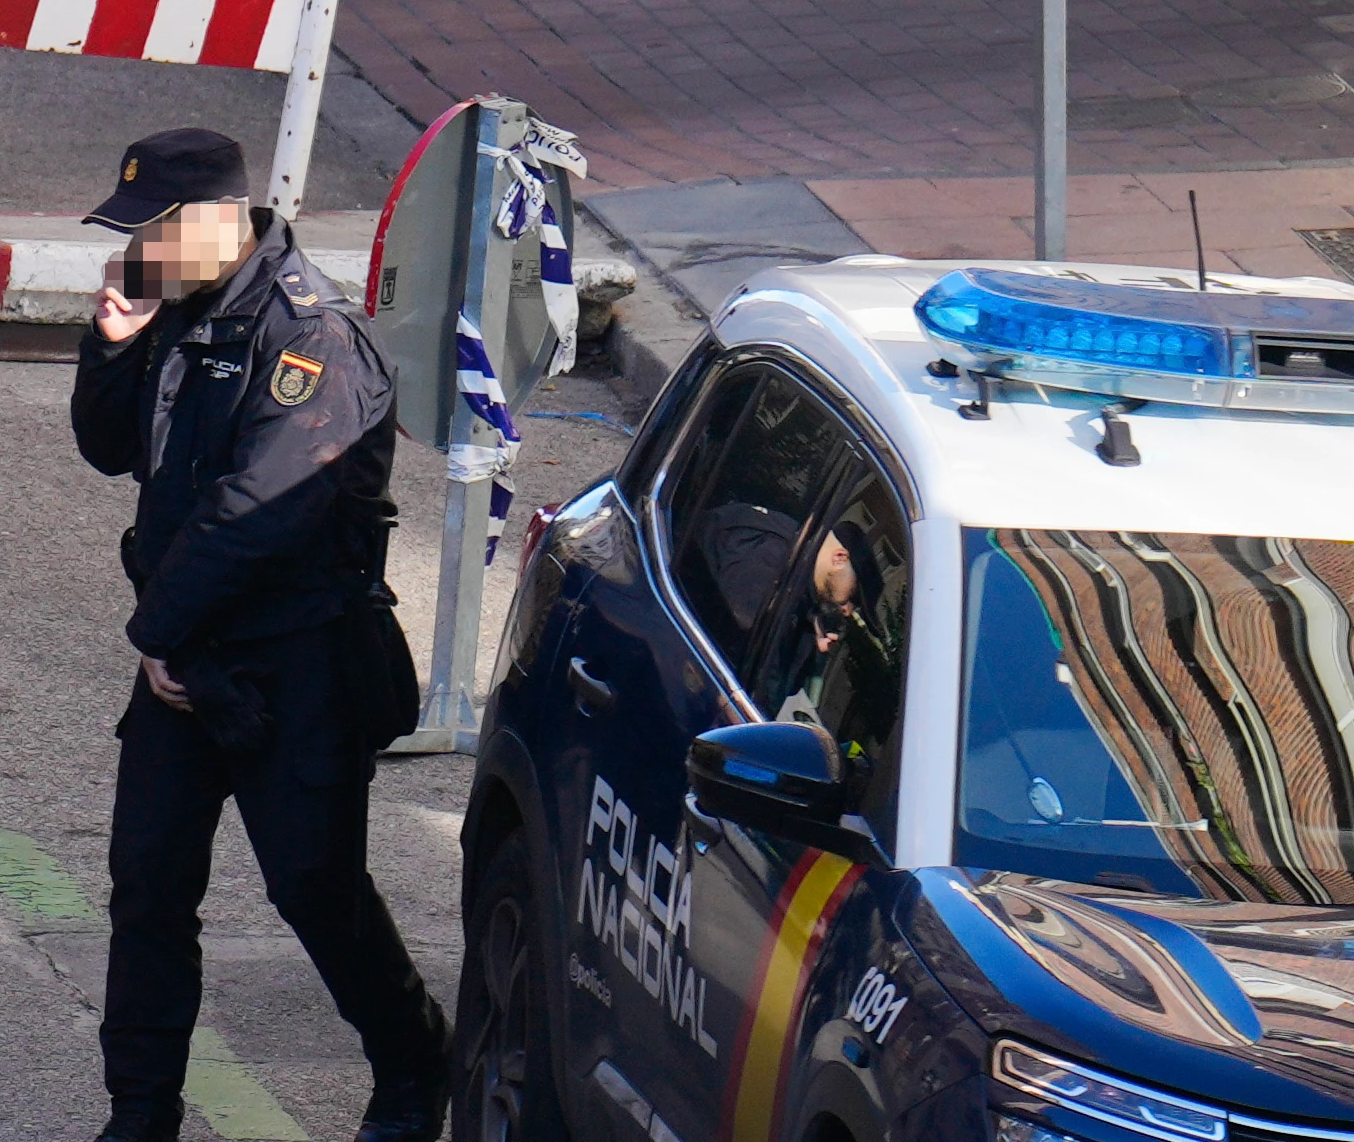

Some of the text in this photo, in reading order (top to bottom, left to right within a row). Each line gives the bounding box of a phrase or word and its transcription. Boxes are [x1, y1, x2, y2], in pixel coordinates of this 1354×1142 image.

[586, 774, 693, 950] POLICÍA
[577, 858, 719, 1059] NACIONAL
[853, 973, 909, 1045] 091
